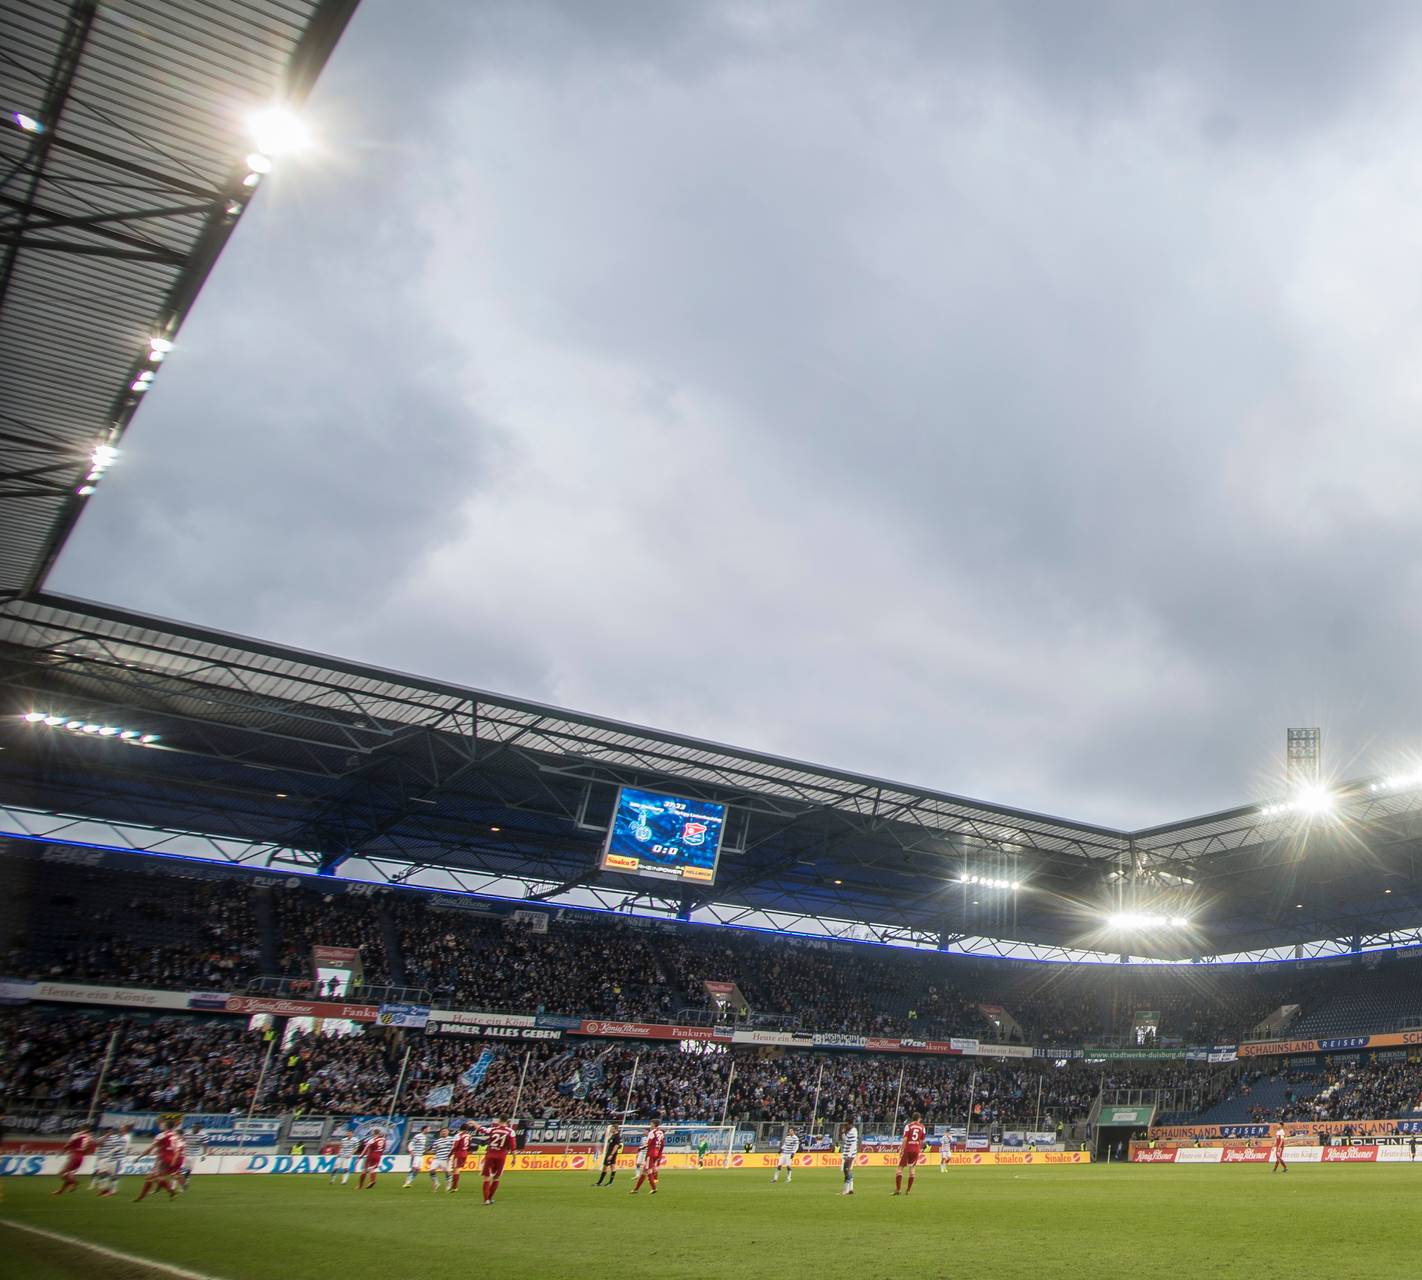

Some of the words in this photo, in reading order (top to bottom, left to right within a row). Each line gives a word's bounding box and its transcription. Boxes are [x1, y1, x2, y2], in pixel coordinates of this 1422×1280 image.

[342, 1007, 377, 1018] Fanku
[440, 1023, 480, 1036] IMMER
[484, 1026, 519, 1037] ALLES
[522, 1029, 562, 1039] GEBEN!
[672, 1028, 712, 1038] Fankurve
[1244, 1041, 1314, 1056] SCHAUINSLAND
[1322, 1037, 1366, 1048] REISEN
[912, 1129, 919, 1141] 5
[1151, 1127, 1217, 1139] SCHAUINSLAND
[1224, 1126, 1264, 1136] REISEN
[490, 1134, 509, 1147] 21
[1045, 1152, 1072, 1162] Sinalco
[1325, 1145, 1350, 1161] König
[1346, 1143, 1373, 1159] Pilsener
[521, 1156, 568, 1169] Sinalco
[763, 1156, 800, 1166] Sinco
[995, 1154, 1023, 1164] Sinalco
